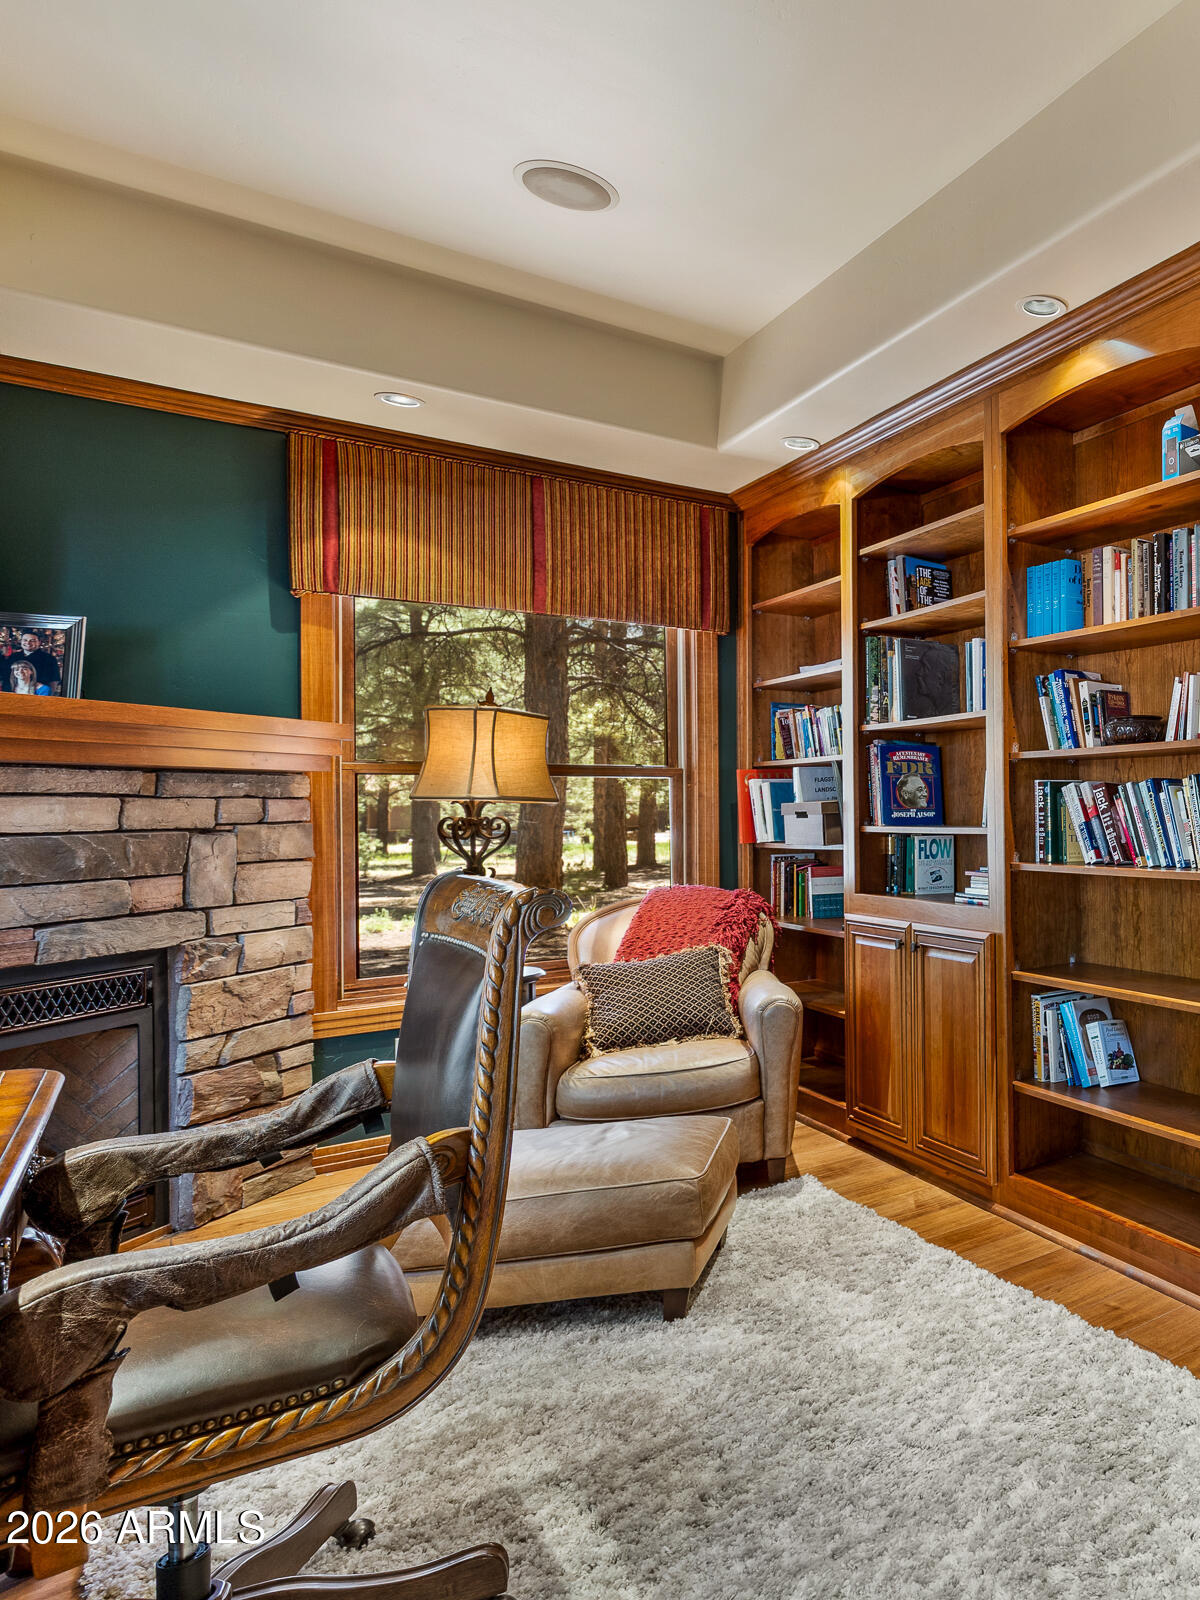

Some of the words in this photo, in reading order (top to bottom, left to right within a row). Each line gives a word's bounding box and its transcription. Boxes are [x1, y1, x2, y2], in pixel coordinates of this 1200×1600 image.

[919, 567, 932, 579] THE
[919, 577, 932, 587] AGE
[919, 586, 928, 596] OF
[919, 595, 934, 606] THE
[886, 761, 934, 775] FDR
[1093, 786, 1109, 811] jack
[892, 811, 917, 819] JOSEPH
[917, 811, 937, 819] ALSOP
[918, 838, 953, 860] FLOW
